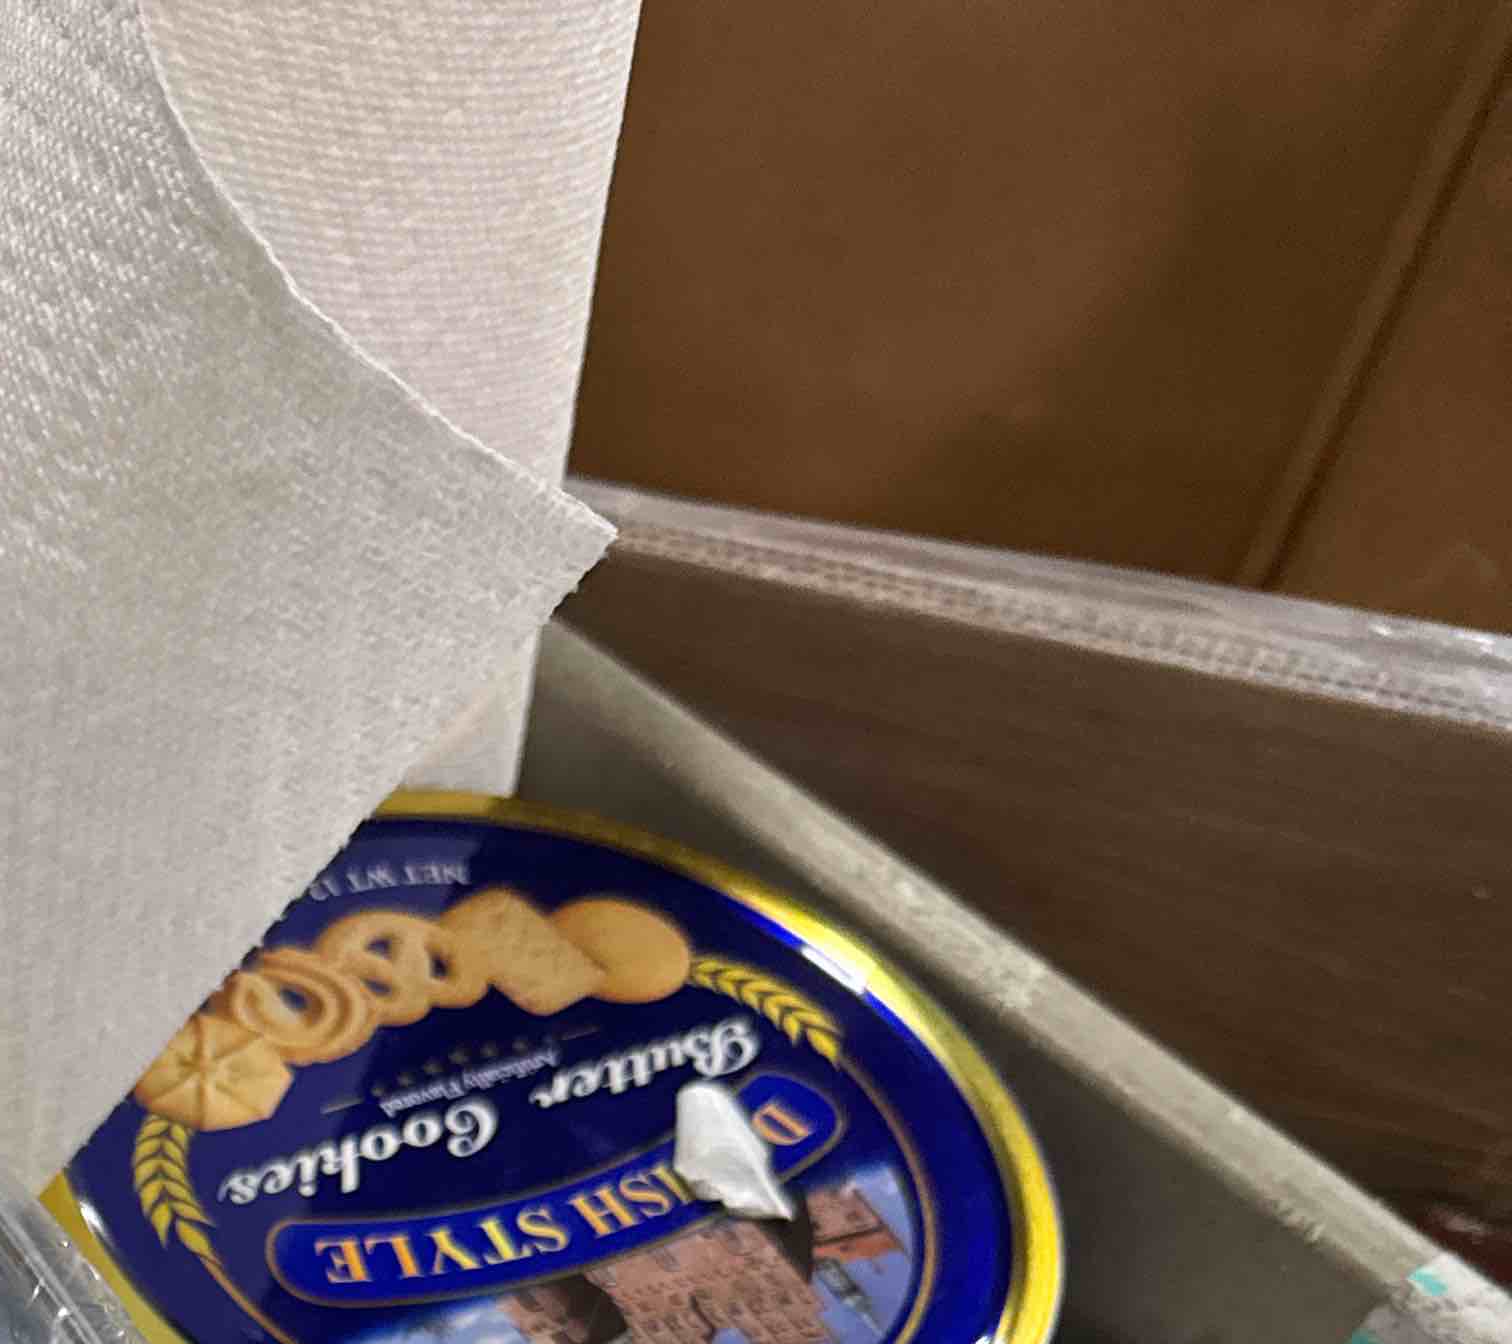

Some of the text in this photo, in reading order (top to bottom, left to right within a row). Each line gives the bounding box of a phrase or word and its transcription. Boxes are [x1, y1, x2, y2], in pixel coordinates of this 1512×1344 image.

[217, 1014, 760, 1205] Butter Cookies
[314, 1103, 811, 1285] DISH STYLE
